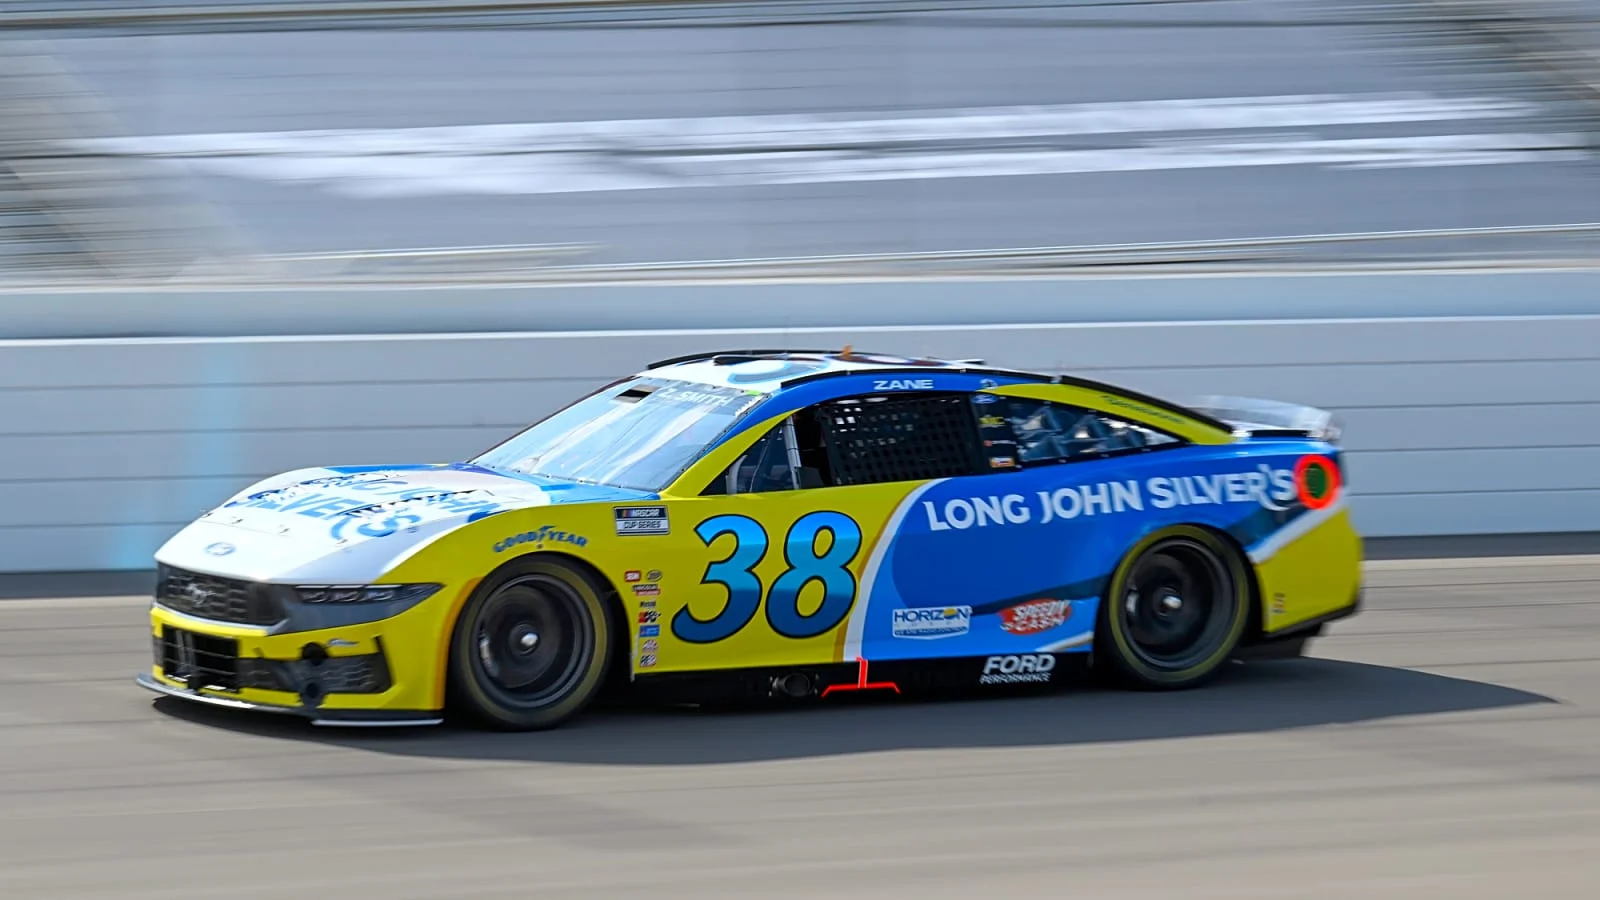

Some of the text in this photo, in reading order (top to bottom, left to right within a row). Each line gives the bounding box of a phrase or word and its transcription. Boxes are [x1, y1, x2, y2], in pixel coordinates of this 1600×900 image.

[873, 379, 934, 390] ZANE
[680, 391, 736, 406] SMITH
[922, 463, 1295, 531] LONG JOHN SILVER'S
[632, 508, 660, 518] NASCAR
[624, 520, 661, 530] CUP SERIES
[493, 525, 588, 553] GOODYEAR
[671, 510, 862, 644] 38
[894, 607, 969, 623] HORIZON
[983, 654, 1056, 675] FORD
[980, 671, 1052, 685] PERFORMANCE
